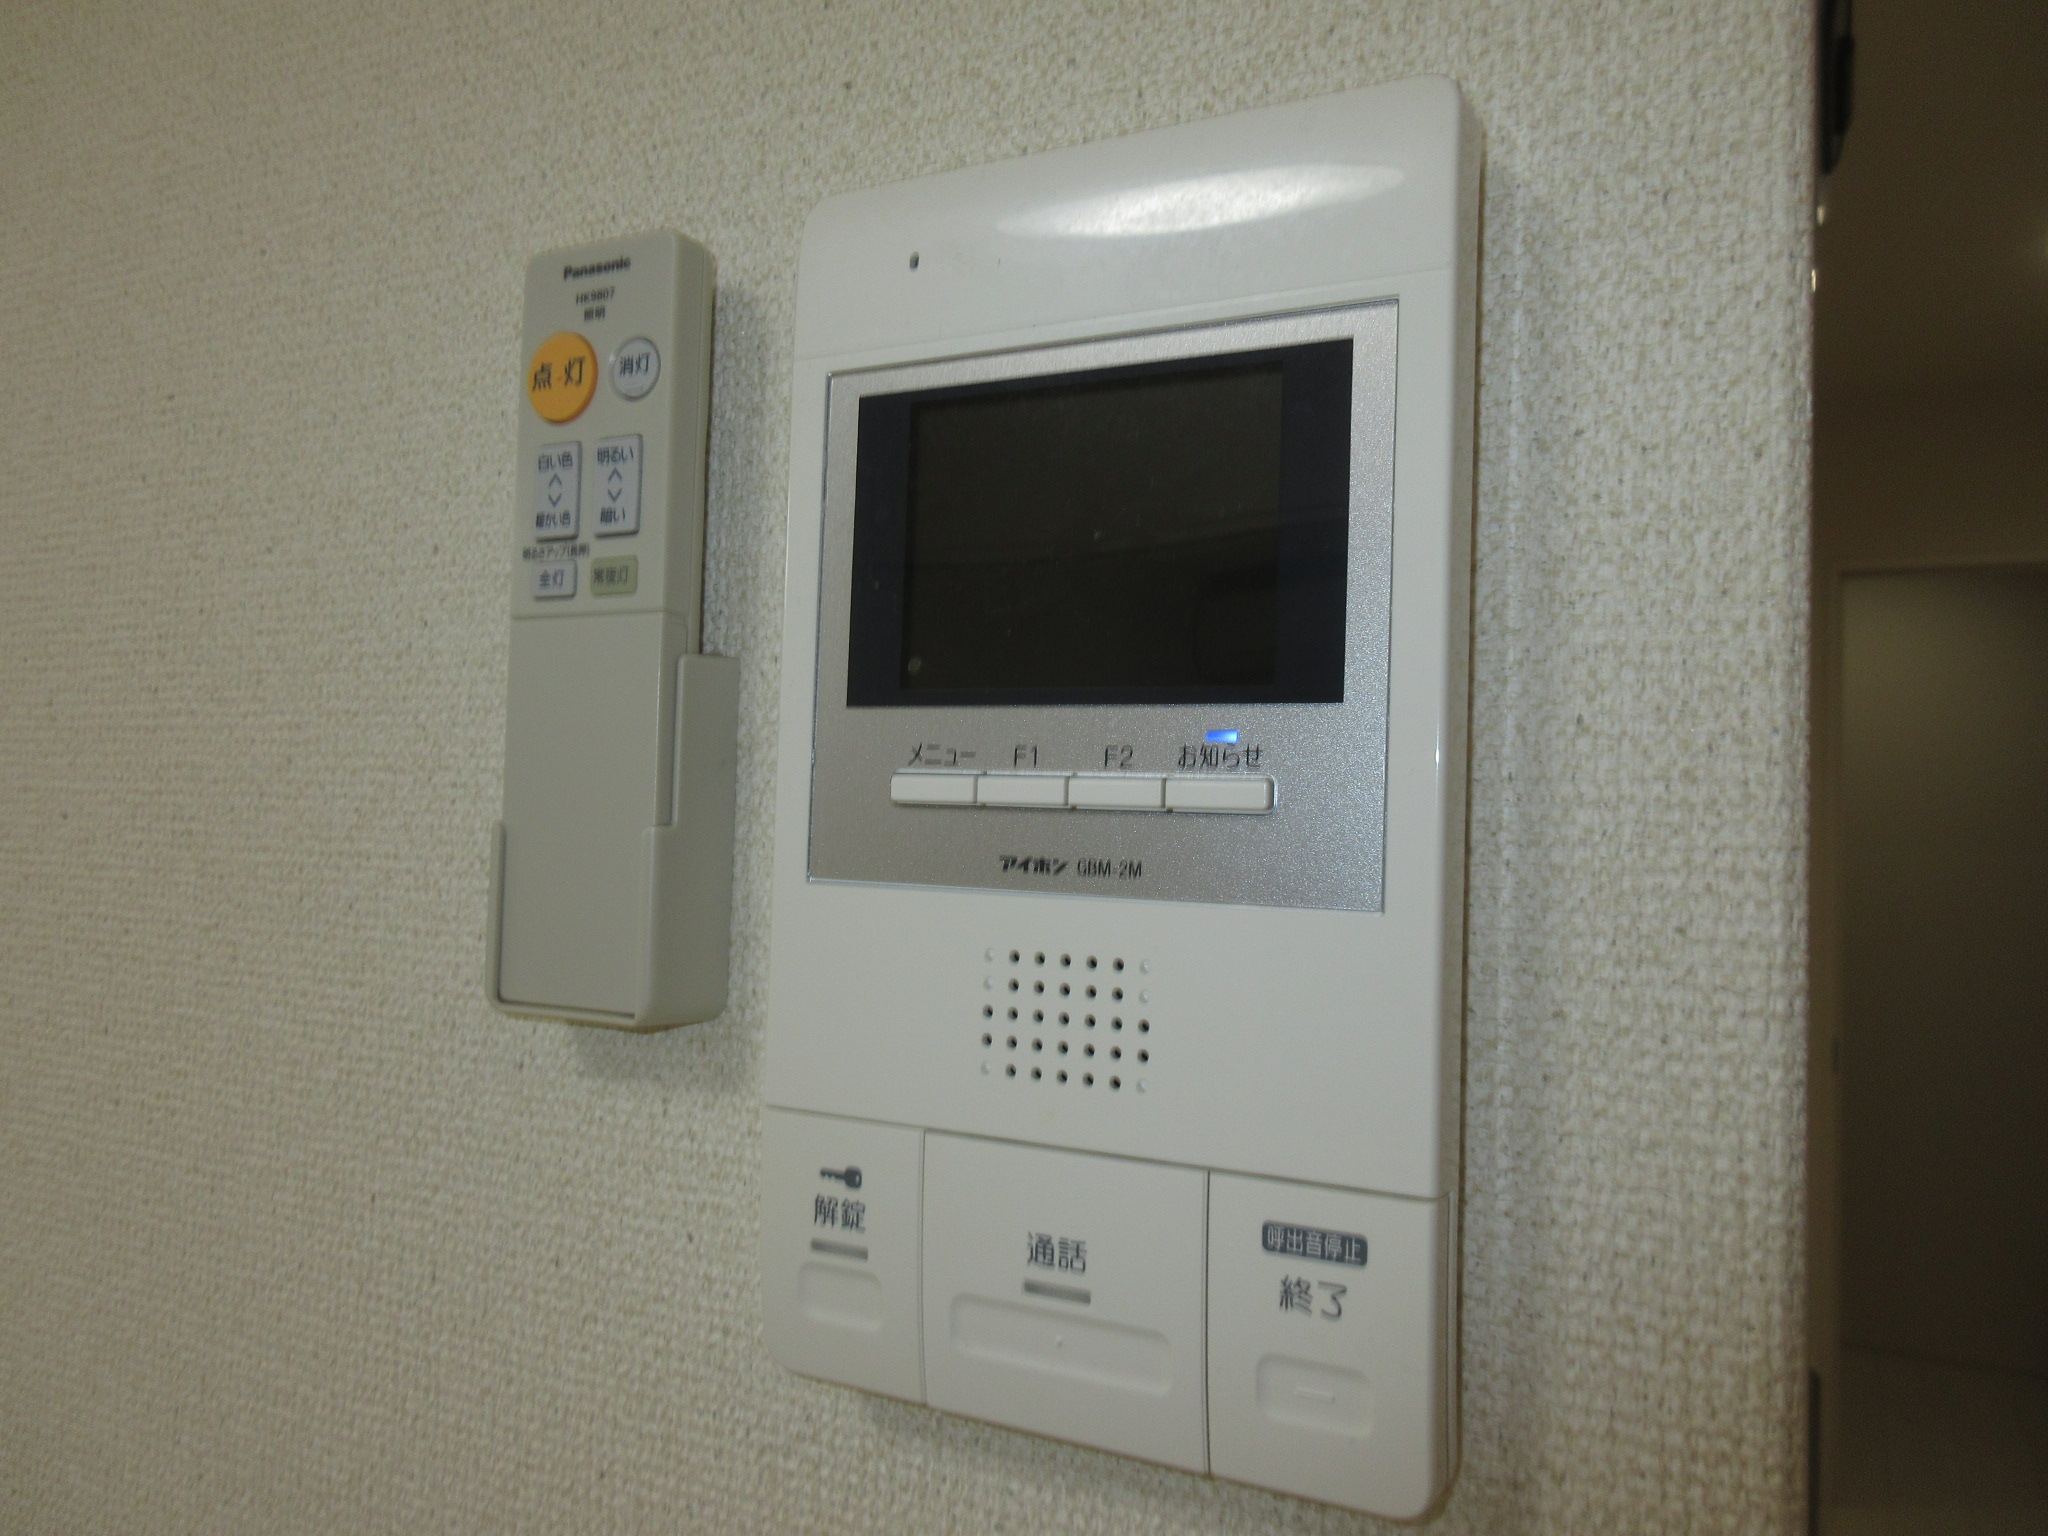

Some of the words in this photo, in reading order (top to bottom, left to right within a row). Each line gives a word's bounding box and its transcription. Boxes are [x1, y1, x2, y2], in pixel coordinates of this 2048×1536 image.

[563, 256, 632, 280] Panasonic
[619, 353, 650, 377] 消灯
[538, 451, 573, 473] 白い色
[597, 446, 634, 465] 明るい
[539, 569, 564, 588] 全灯
[908, 742, 977, 767] メニュー
[1013, 745, 1038, 767] F1
[1104, 745, 1134, 768] F2
[1177, 743, 1264, 770] お知らせ
[1001, 855, 1068, 874] アイホン
[1076, 857, 1142, 879] GBM-2M
[813, 1194, 867, 1234] 解錠
[1026, 1232, 1088, 1273] 通話
[1266, 1224, 1362, 1265] 呼出音停止
[1278, 1274, 1348, 1320] 終了
